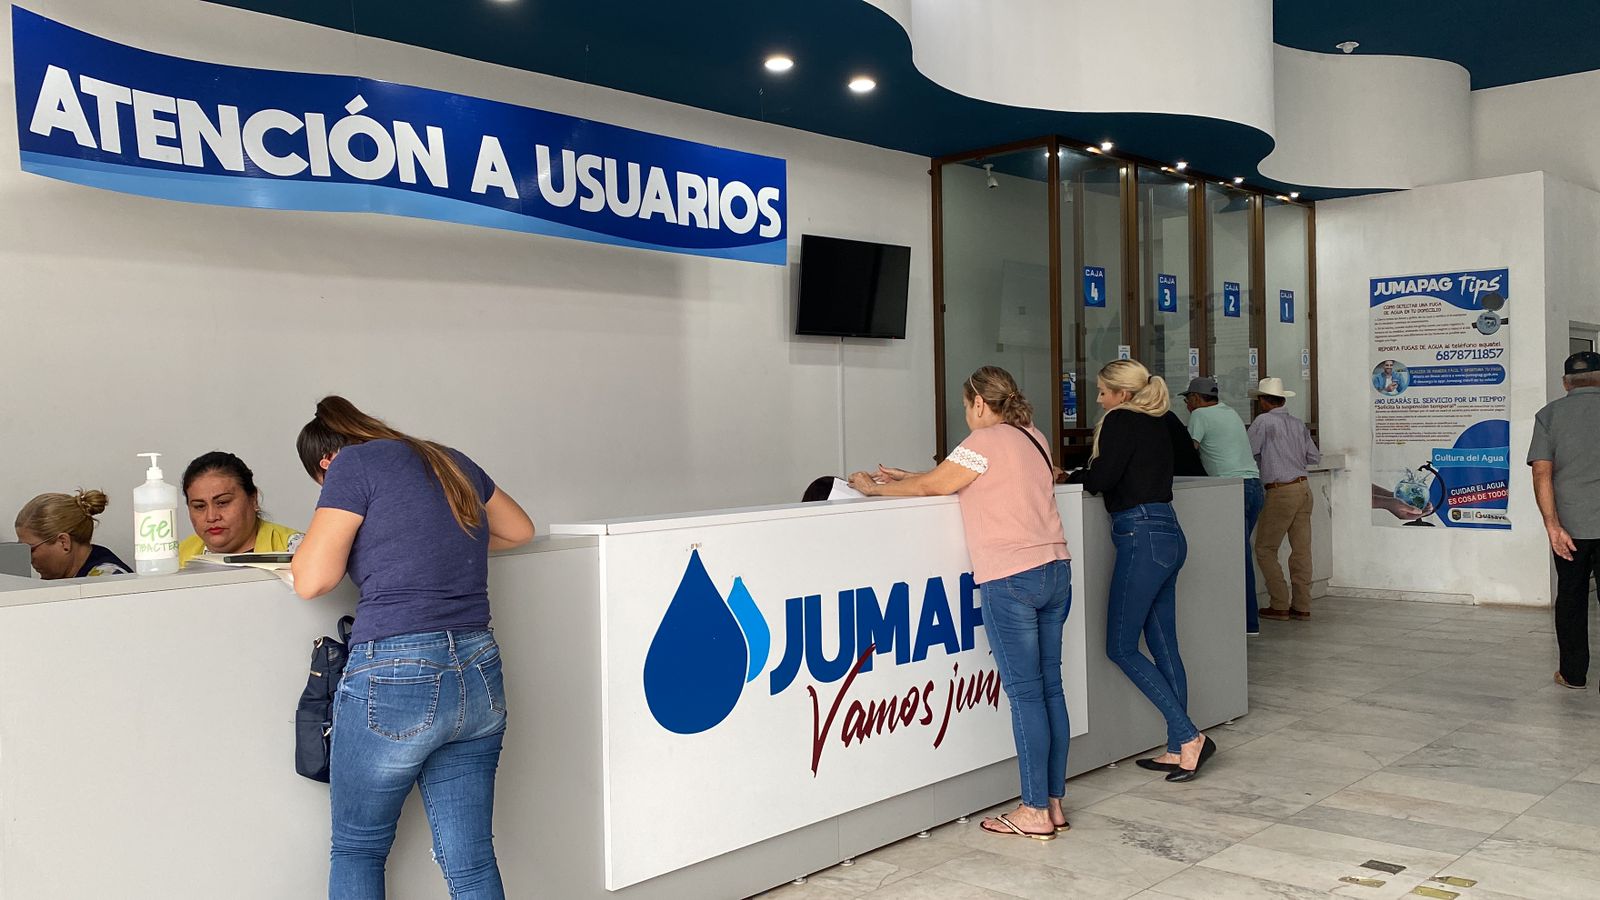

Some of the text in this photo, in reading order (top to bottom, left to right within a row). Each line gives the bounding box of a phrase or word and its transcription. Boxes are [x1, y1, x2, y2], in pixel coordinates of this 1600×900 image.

[29, 64, 782, 239] ATENCIÓN A USUARIOS
[1085, 268, 1104, 278] CAJA
[1159, 276, 1175, 285] CAJA
[1090, 282, 1099, 301] 4
[1225, 283, 1240, 292] CAJA
[1374, 274, 1502, 305] JUMAPAG Tips
[1163, 288, 1170, 306] 3
[1229, 295, 1235, 312] 2
[1284, 302, 1289, 318] 1
[1436, 348, 1504, 361] 6878711857
[1434, 453, 1504, 464] Cultura del Agua
[1451, 481, 1505, 496] CUIDAR EL AGUA
[1448, 498, 1457, 506] ES
[1458, 493, 1478, 504] COSA
[1478, 492, 1488, 500] DE
[139, 510, 174, 542] Gel
[806, 643, 935, 778] Vamos
